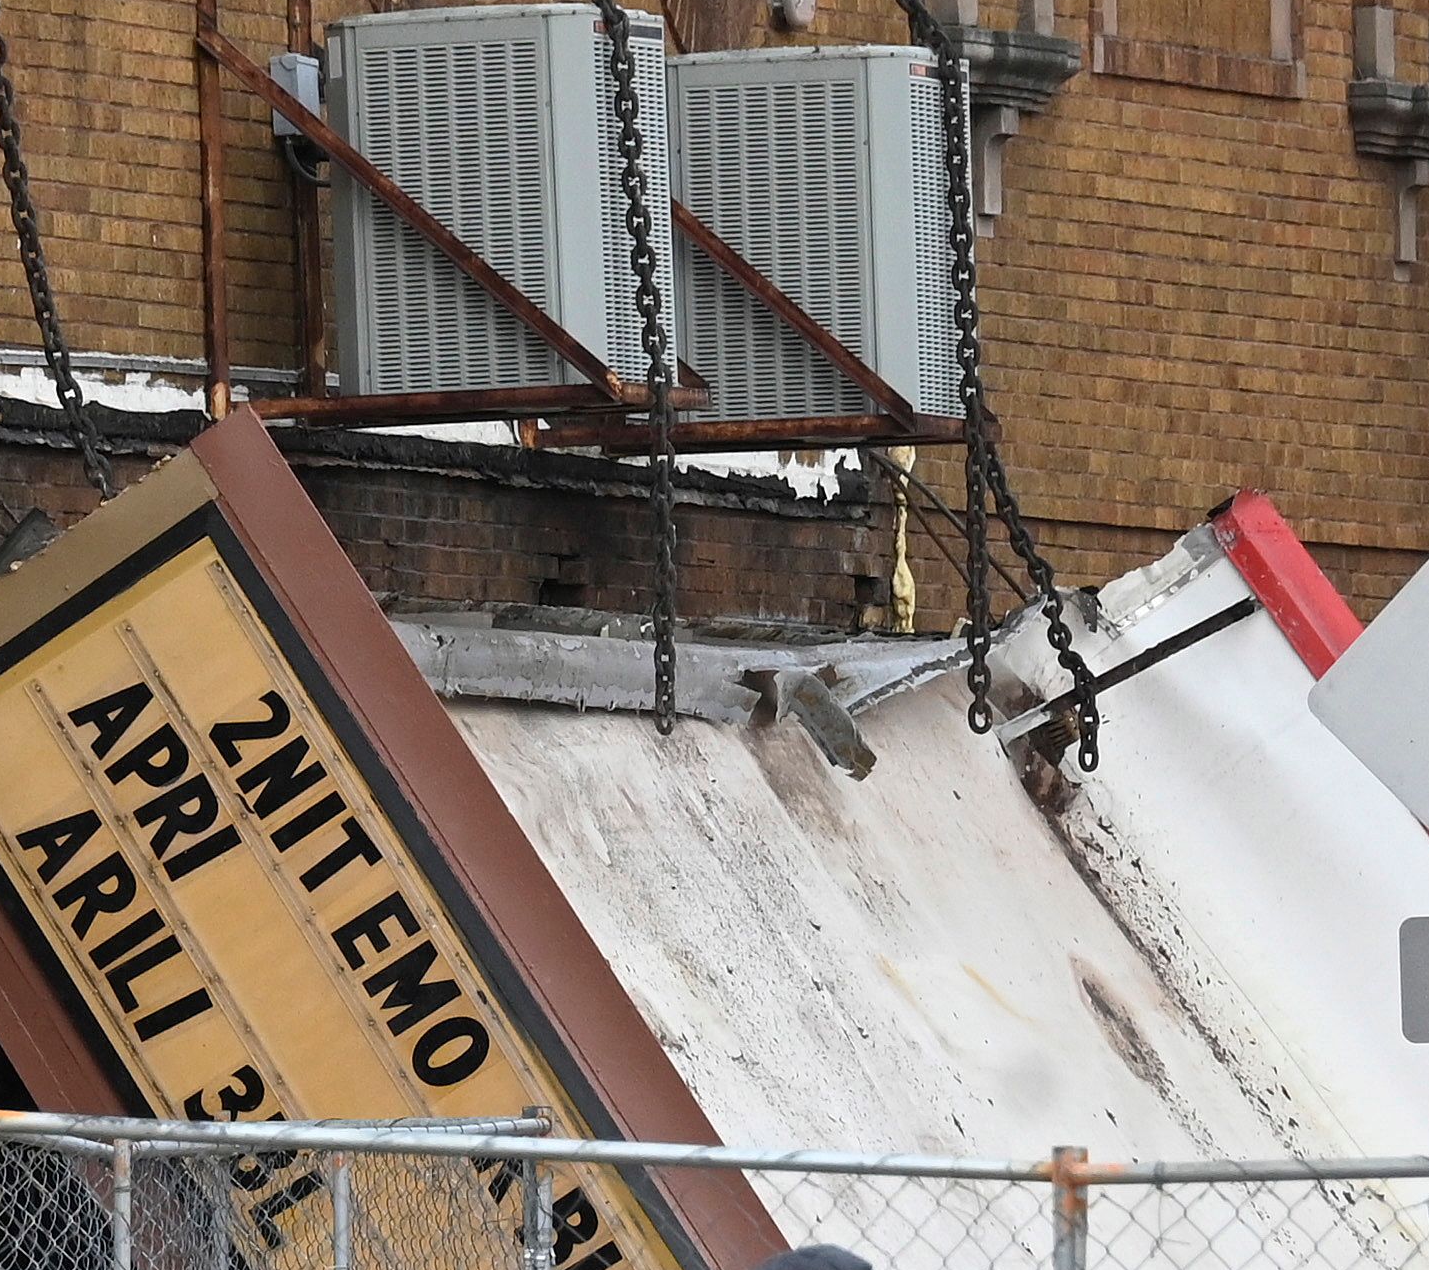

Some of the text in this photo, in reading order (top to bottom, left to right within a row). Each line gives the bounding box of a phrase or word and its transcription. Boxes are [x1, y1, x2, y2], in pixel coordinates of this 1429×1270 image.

[68, 681, 242, 881] APRI
[209, 690, 383, 893] 2NIT
[332, 890, 491, 1087] EMO
[16, 809, 213, 1042] ARILI
